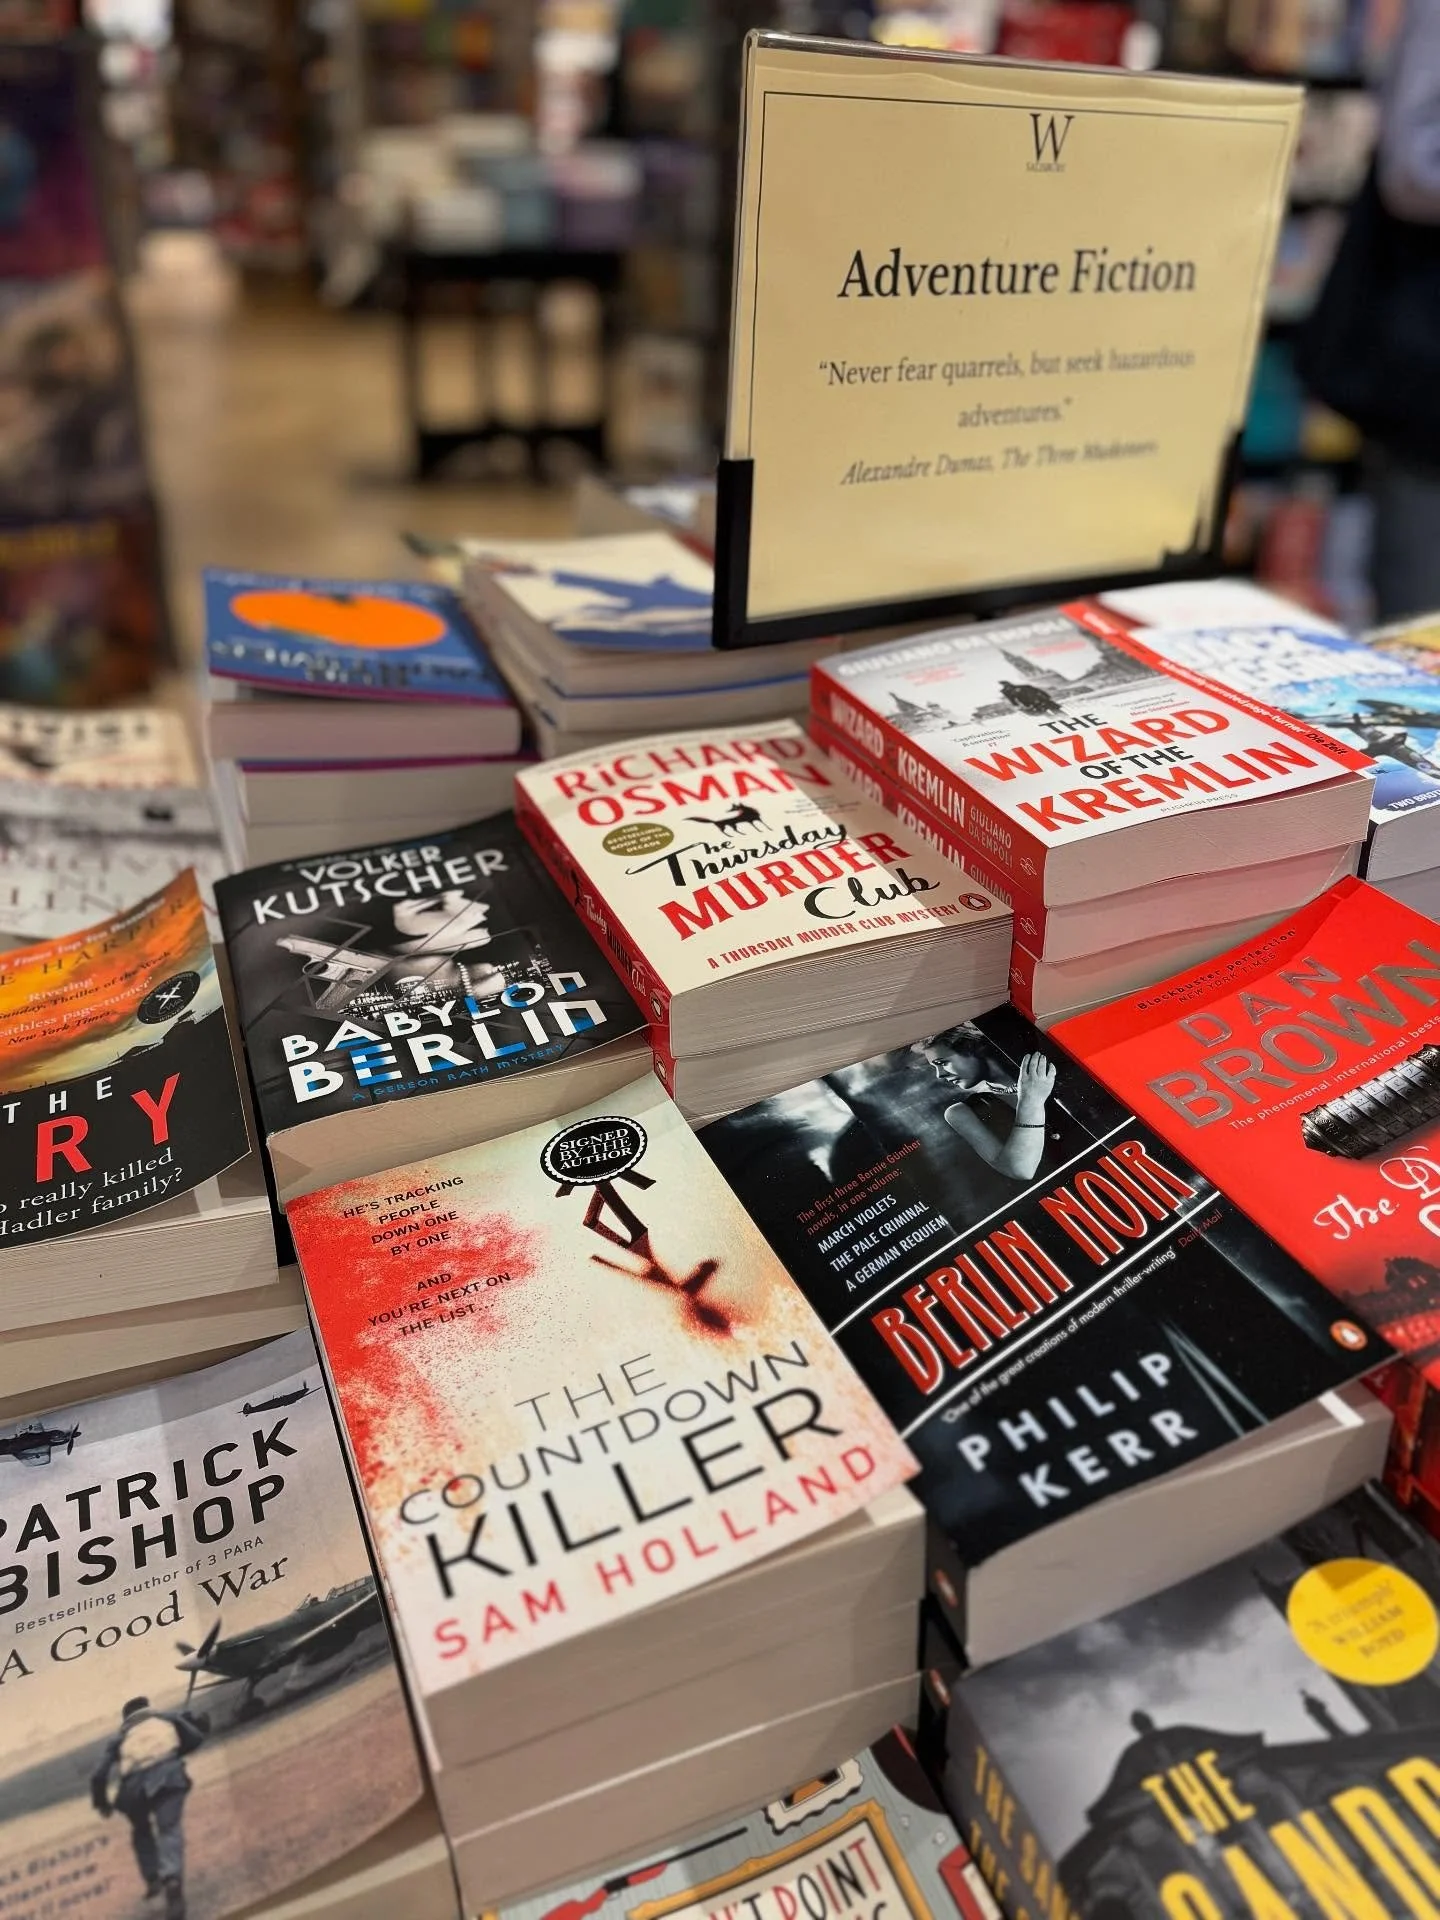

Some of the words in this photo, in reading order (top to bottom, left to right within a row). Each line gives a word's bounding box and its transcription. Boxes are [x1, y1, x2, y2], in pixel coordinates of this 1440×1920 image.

[1030, 113, 1075, 162] W
[837, 248, 1059, 298] Adventure
[1070, 248, 1196, 293] Fiction
[897, 358, 934, 381] fear
[941, 353, 1025, 386] quarrels,
[1031, 352, 1060, 375] but
[1066, 350, 1104, 374] seek
[1109, 348, 1195, 372] hazardous
[840, 457, 930, 485] Alexandre
[935, 454, 993, 478] Dumas,
[1002, 448, 1030, 470] The
[1036, 445, 1076, 466] Three
[963, 708, 1231, 782] WIZARD
[1038, 713, 1108, 736] THE
[1305, 732, 1323, 745] Die
[1323, 741, 1347, 756] Zeit
[828, 692, 884, 760] WIZARD
[897, 747, 965, 828] KREMLIN
[970, 806, 1012, 850] GIULIANO
[1016, 741, 1319, 833] KREMLIN
[1079, 757, 1124, 780] OF
[1113, 745, 1194, 774] THE
[577, 763, 832, 827] OSMAN
[1388, 798, 1415, 809] TWO
[300, 845, 442, 884] VOLKER
[625, 822, 847, 886] Thursday
[981, 832, 1013, 869] EMPOLI
[253, 849, 508, 924] KUTSCHER
[658, 832, 913, 941] MURDER
[804, 868, 940, 919] Club
[707, 957, 719, 969] A
[720, 936, 794, 966] THURSDAY
[797, 922, 858, 948] MURDER
[860, 912, 896, 930] CLUB
[897, 903, 959, 925] MYSTERY
[103, 979, 115, 989] of
[1178, 986, 1204, 1004] NEW
[1208, 970, 1238, 993] YORK
[1241, 951, 1277, 976] TIMES
[1178, 957, 1342, 1048] DAN
[8, 1034, 36, 1046] New
[40, 1024, 70, 1038] York
[281, 971, 588, 1062] BABYLON
[1146, 939, 1440, 1128] BROWN
[288, 1000, 607, 1103] BERLIN
[448, 1066, 489, 1082] RATH
[497, 1043, 564, 1069] MYSTERY
[3, 1076, 113, 1124] THE
[1228, 1114, 1255, 1132] The
[1257, 1080, 1330, 1120] phenomenal
[1333, 1037, 1410, 1084] international
[560, 1128, 629, 1151] SIGNED
[560, 1148, 583, 1161] BY
[588, 1136, 632, 1155] THE
[560, 1147, 633, 1170] AUTHOR
[19, 1182, 93, 1210] really
[102, 1147, 174, 1188] killed
[91, 1167, 183, 1215] family?
[344, 1201, 380, 1218] HE'S
[384, 1176, 464, 1206] TRACKING
[797, 1208, 815, 1224] The
[815, 1195, 834, 1211] first
[835, 1180, 858, 1199] three
[858, 1162, 887, 1183] Bernie
[807, 1211, 839, 1235] novels,
[839, 1202, 849, 1213] in
[850, 1192, 867, 1206] one
[868, 1168, 902, 1193] volume:
[371, 1222, 420, 1244] DOWN
[425, 1211, 459, 1228] ONE
[378, 1200, 440, 1224] PEOPLE
[391, 1243, 411, 1256] BY
[417, 1230, 451, 1248] ONE
[818, 1221, 856, 1254] MARCH
[854, 1194, 897, 1226] VIOLETS
[829, 1251, 854, 1272] THE
[852, 1232, 880, 1256] PALE
[879, 1200, 930, 1237] CRIMINAL
[1313, 1194, 1399, 1240] The
[417, 1273, 452, 1291] AND
[845, 1279, 856, 1292] A
[855, 1246, 901, 1283] GERMAN
[899, 1214, 949, 1252] REQUIEM
[870, 1219, 1075, 1395] BERLIN
[1039, 1138, 1198, 1266] NOIR
[368, 1298, 432, 1327] YOU'RE
[438, 1282, 480, 1304] NEXT
[486, 1272, 511, 1287] ON
[399, 1317, 434, 1336] THE
[969, 1390, 983, 1407] of
[980, 1375, 999, 1395] the
[998, 1357, 1025, 1386] great
[1025, 1329, 1068, 1365] creations
[1067, 1316, 1081, 1335] of
[1079, 1294, 1115, 1325] modern
[1177, 1226, 1203, 1248] Daily
[1199, 1210, 1224, 1234] Mail
[514, 1352, 667, 1432] THE
[957, 1352, 1172, 1473] PHILIP
[399, 1339, 811, 1525] COUNTDOWN
[1017, 1409, 1199, 1509] KERR
[425, 1387, 842, 1600] KILLER
[0, 1474, 285, 1616] BISHOP
[434, 1581, 566, 1660] SAM
[596, 1445, 877, 1596] HOLLAND
[15, 1594, 117, 1634] Bestselling
[123, 1570, 180, 1597] author
[185, 1561, 202, 1575] of
[208, 1555, 217, 1567] 3
[223, 1536, 264, 1560] PARA
[0, 1649, 33, 1685] A
[50, 1590, 184, 1662] Good
[198, 1557, 289, 1607] War
[1141, 1750, 1256, 1846] THE
